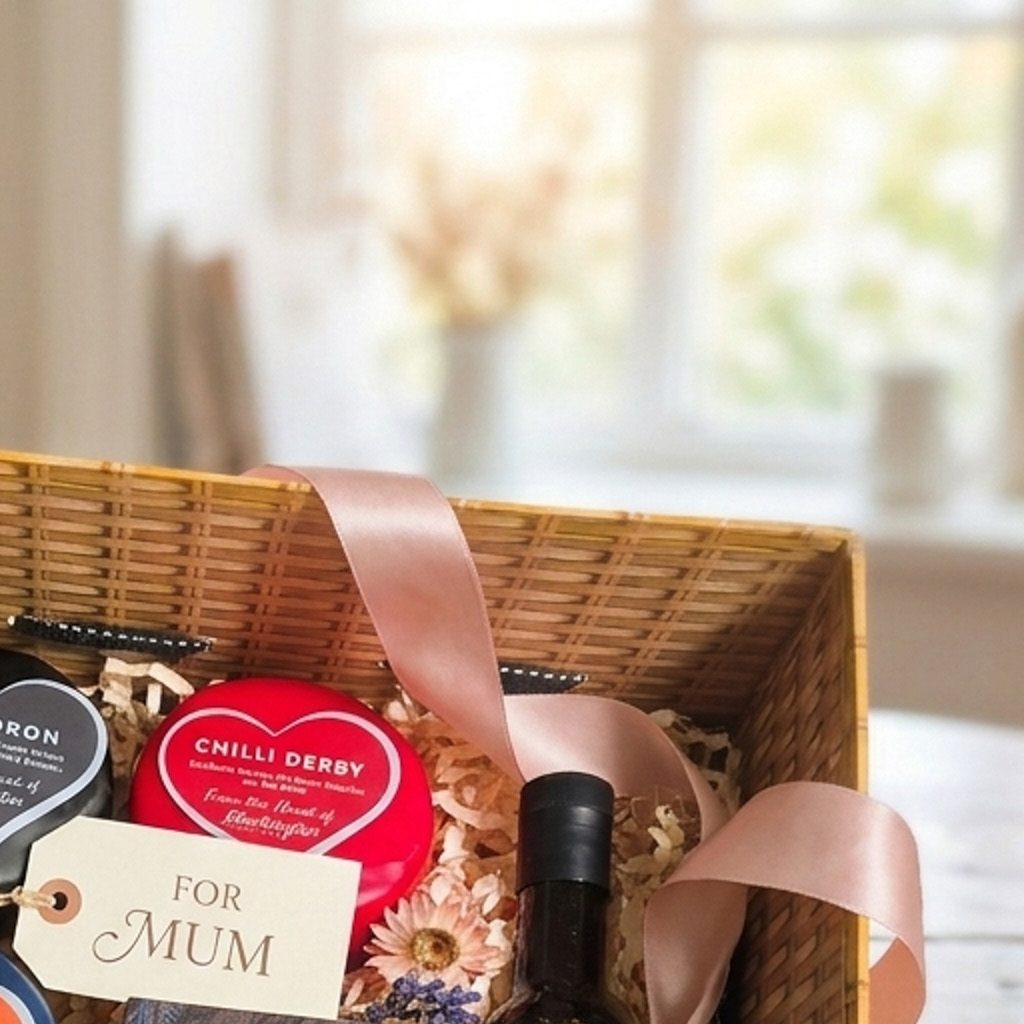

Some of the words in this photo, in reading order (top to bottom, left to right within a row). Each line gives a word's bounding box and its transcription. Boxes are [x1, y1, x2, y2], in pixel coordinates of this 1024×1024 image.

[285, 751, 365, 778] DERBY
[172, 875, 242, 912] FOR
[92, 909, 275, 977] MUM
